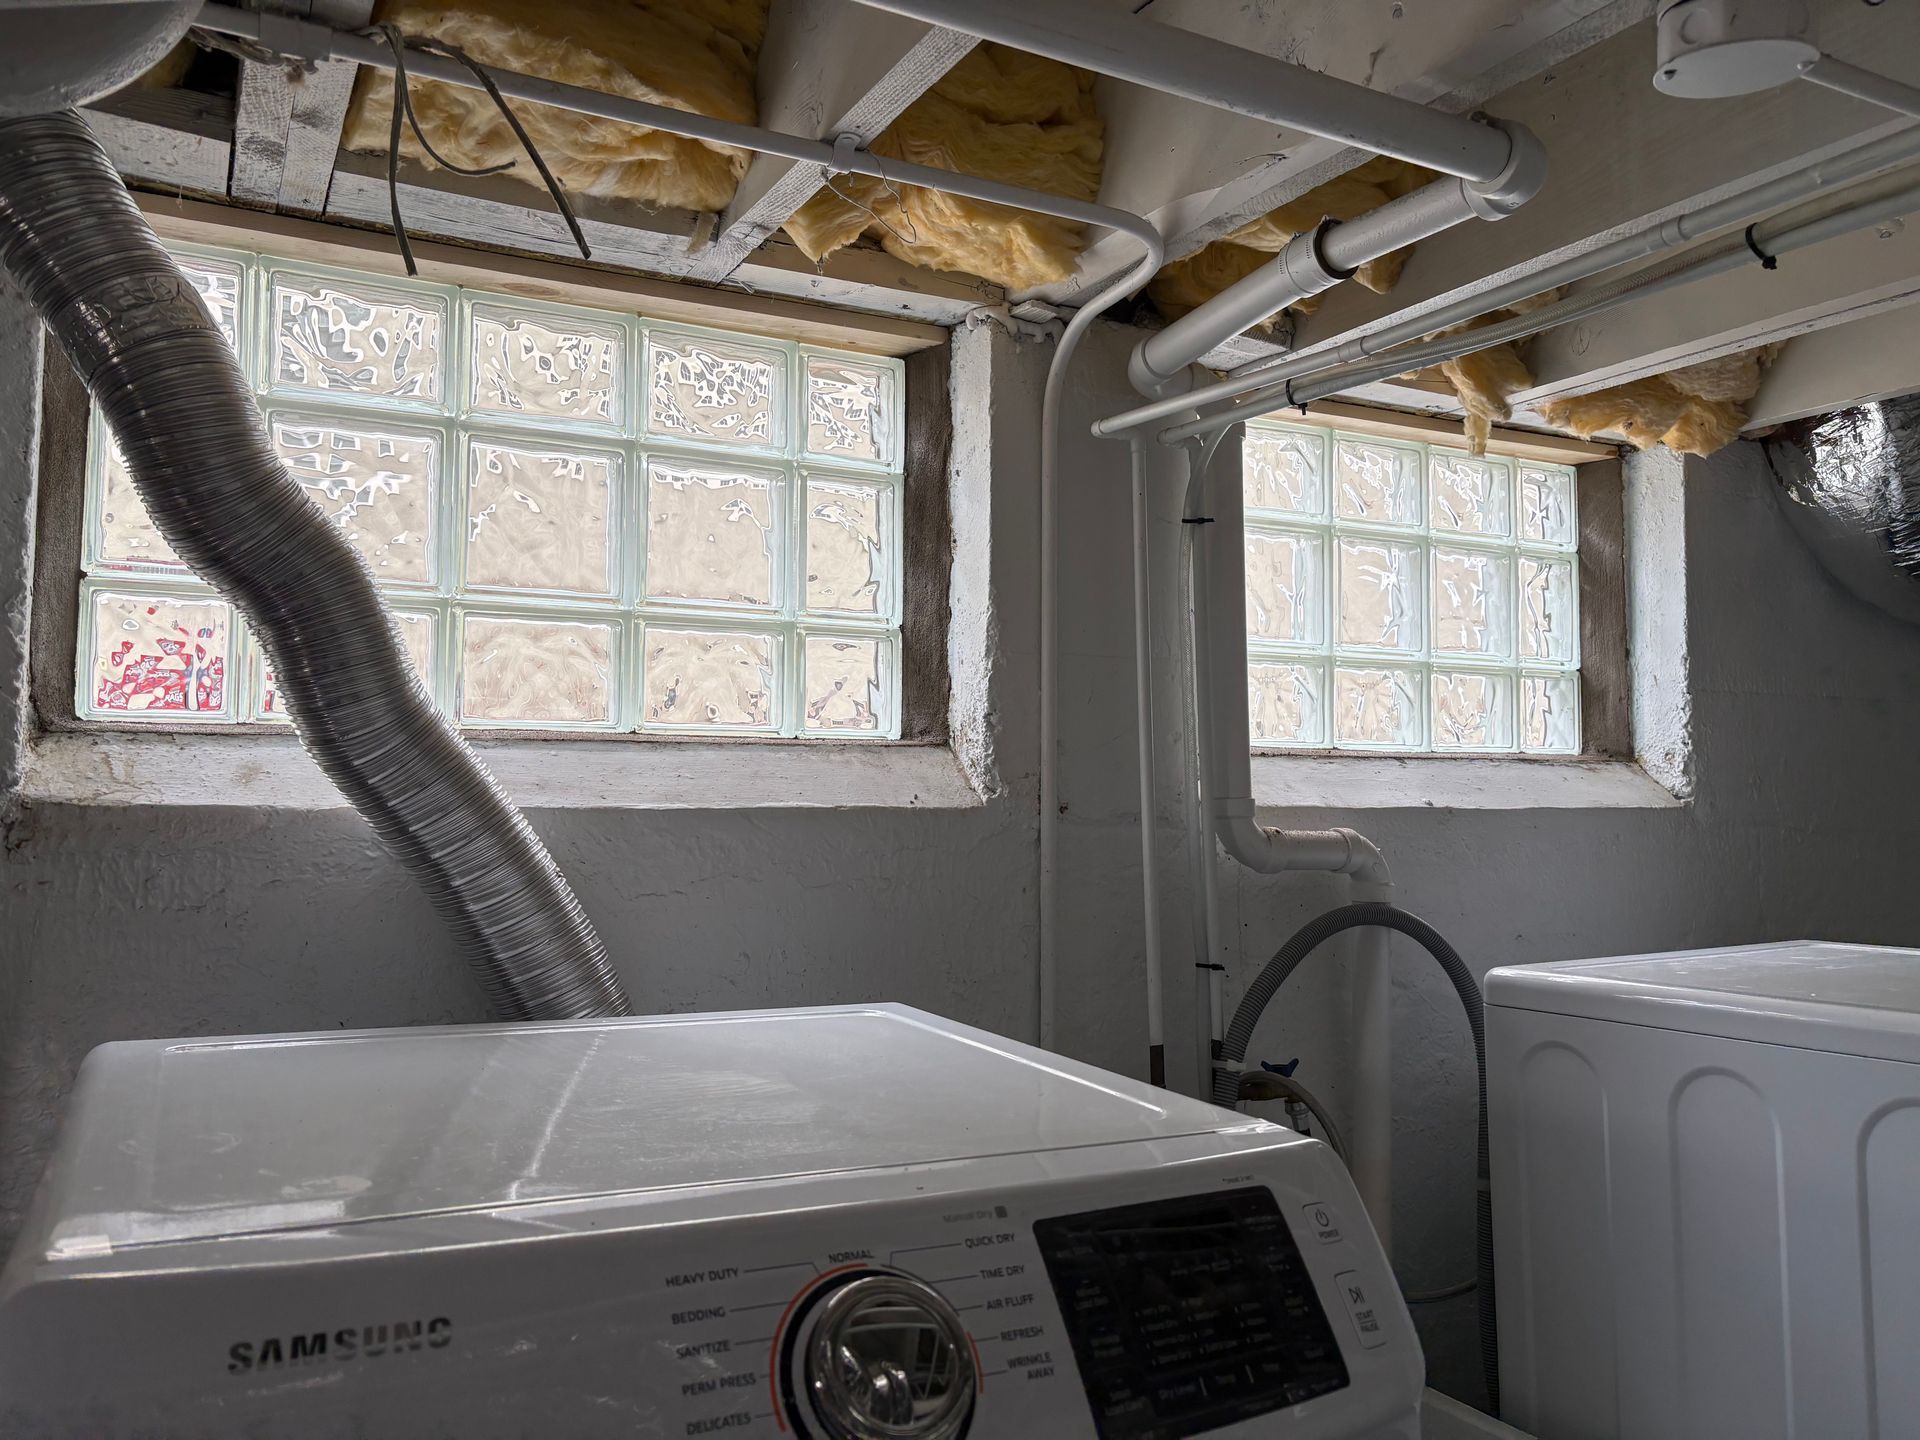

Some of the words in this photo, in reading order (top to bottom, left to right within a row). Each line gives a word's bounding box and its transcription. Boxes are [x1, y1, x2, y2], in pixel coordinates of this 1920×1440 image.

[964, 1236, 996, 1249] QUICK
[996, 1233, 1015, 1244] DRY
[828, 1249, 875, 1264] NORMAL
[665, 1271, 706, 1287] HEAVY
[708, 1267, 739, 1281] DUTY
[980, 1268, 1004, 1280] TIME
[1005, 1265, 1025, 1276] DRY
[986, 1300, 1004, 1311] AIR
[1005, 1294, 1034, 1308] FLUFF
[671, 1306, 726, 1325] BEDDING
[1000, 1326, 1044, 1342] REFRESH
[227, 1316, 452, 1376] SAMSUNG
[676, 1339, 731, 1360] SANITIZE
[1007, 1352, 1053, 1369] WRINKLE
[1027, 1366, 1055, 1380] AWAY
[682, 1380, 717, 1397] PERM
[720, 1372, 757, 1388] PRESS
[686, 1412, 752, 1436] DELICATES
